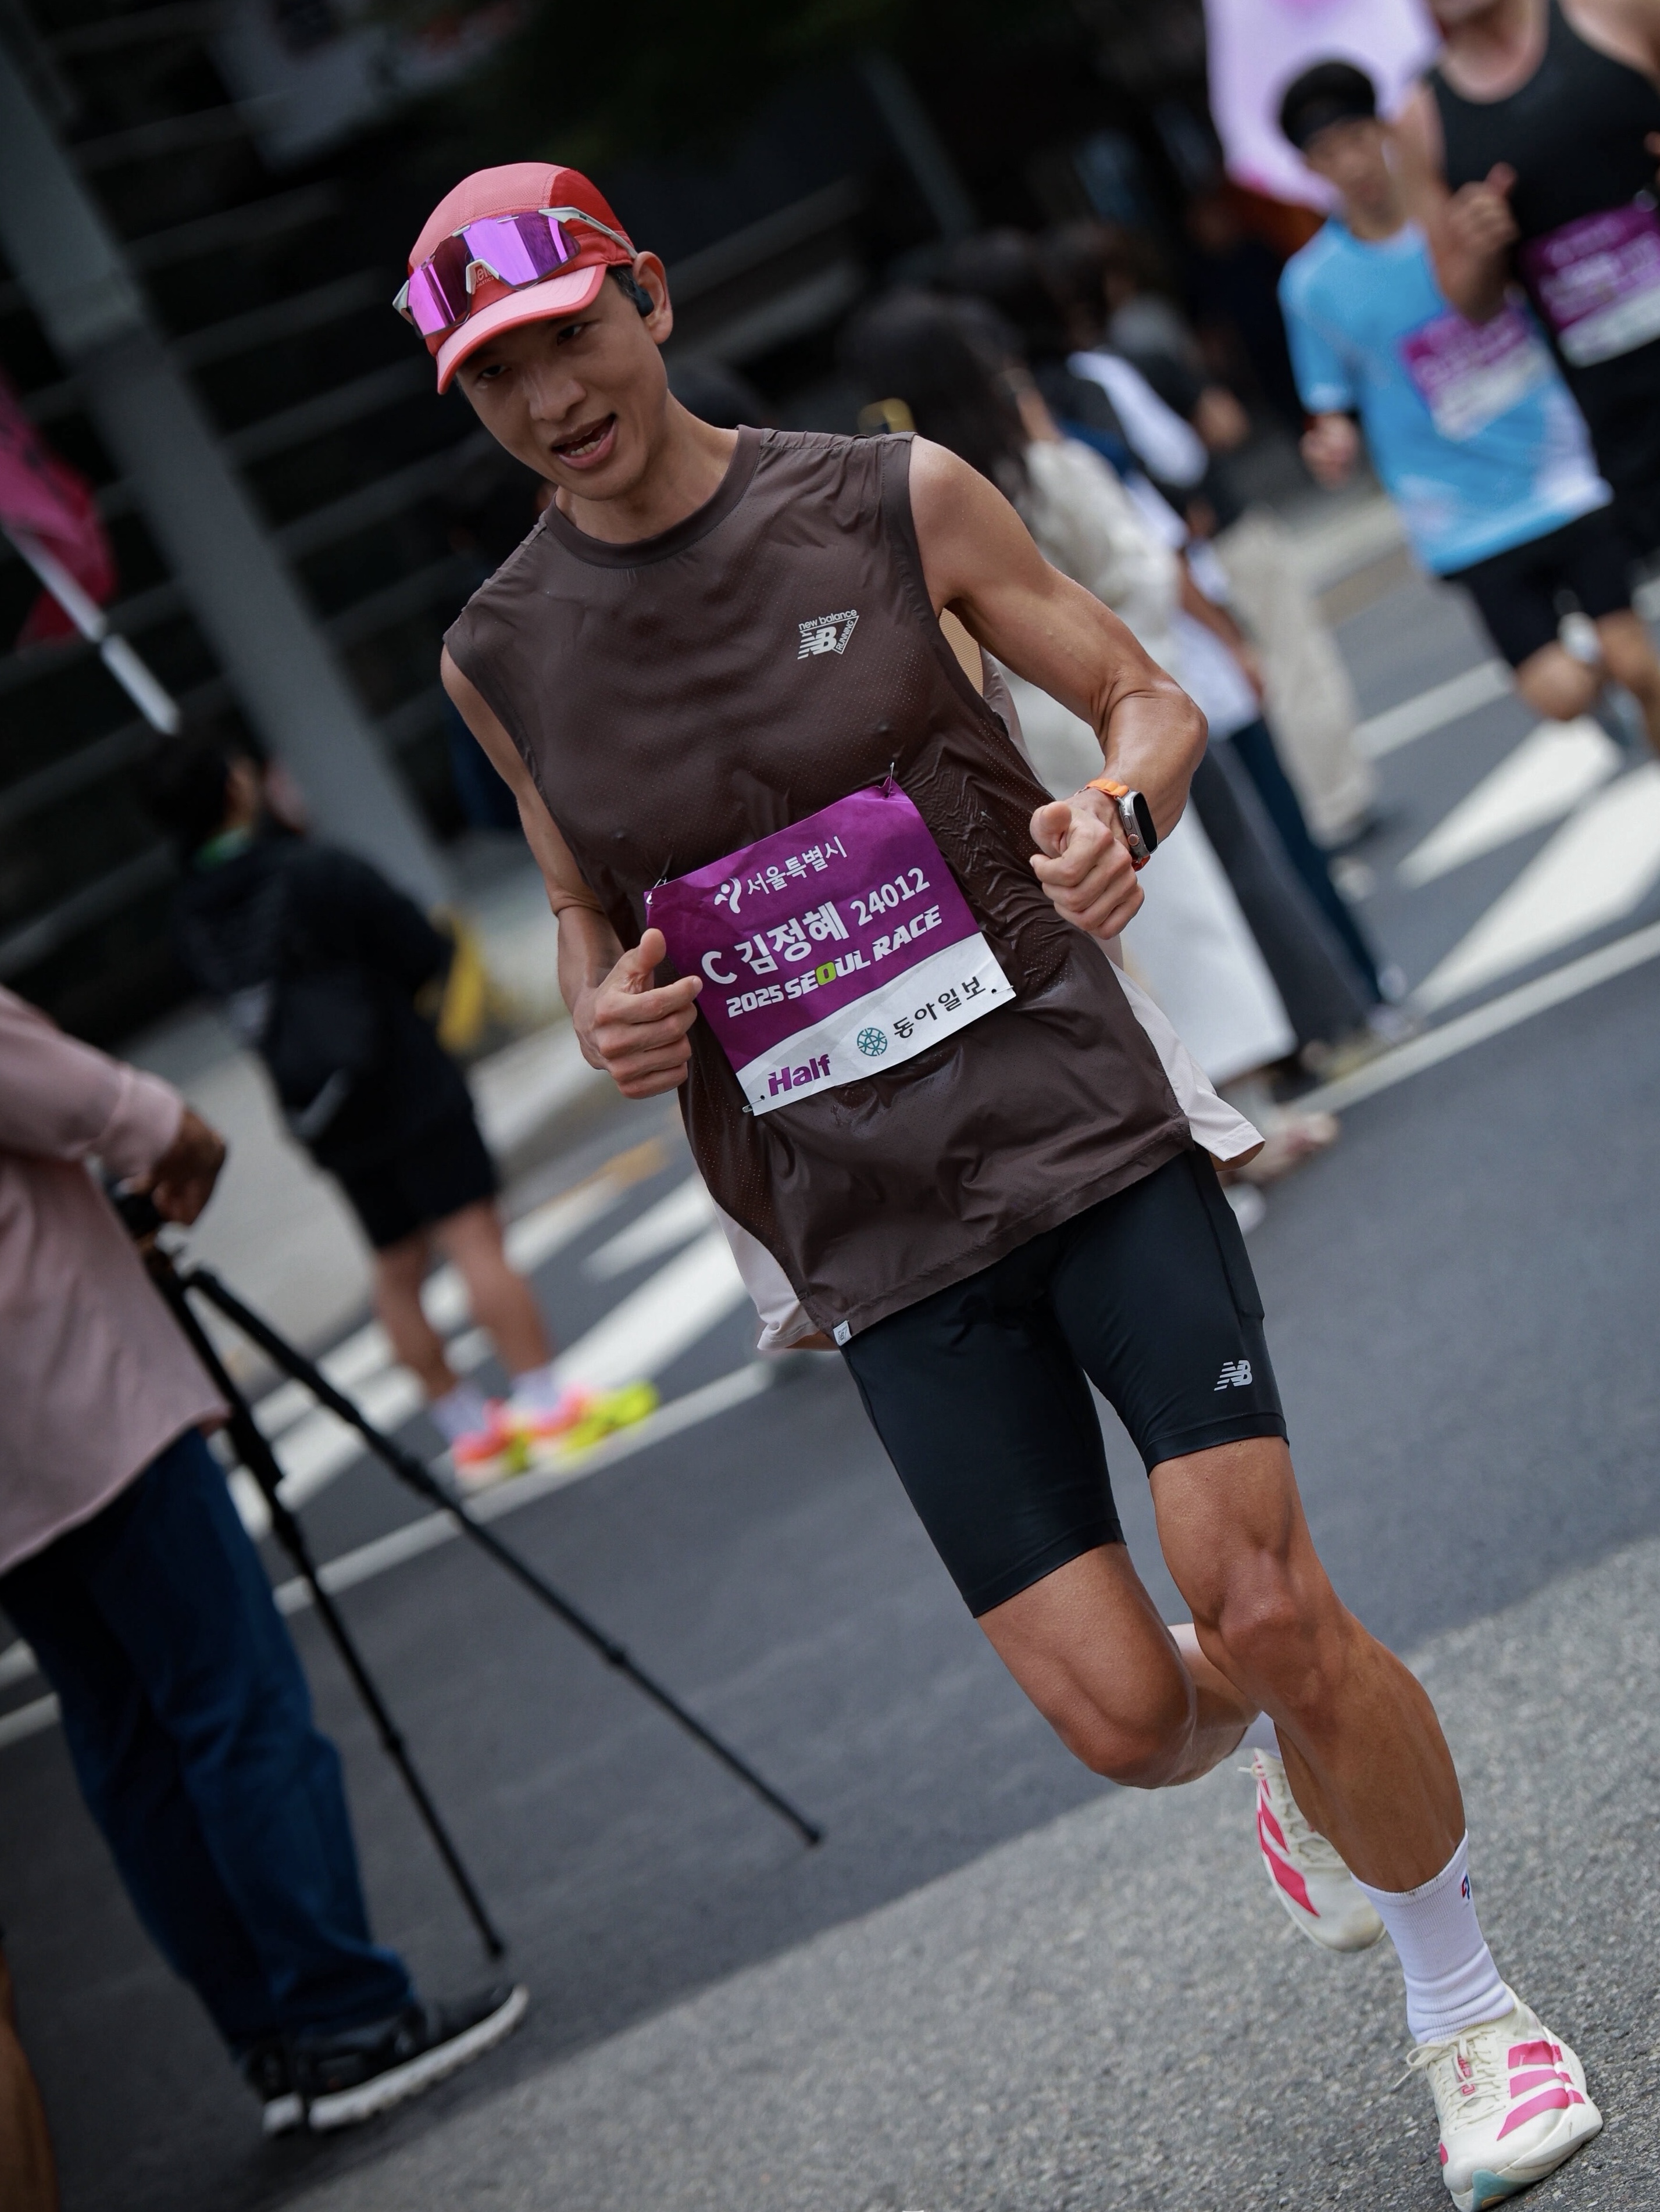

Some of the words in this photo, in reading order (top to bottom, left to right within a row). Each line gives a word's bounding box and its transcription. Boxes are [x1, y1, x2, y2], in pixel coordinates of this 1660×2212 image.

[476, 276, 494, 290] THLETICS
[798, 619, 818, 631] new
[819, 609, 857, 624] balance
[836, 620, 854, 651] RUNNING
[747, 836, 847, 896] 서울특별시
[701, 950, 738, 985] C
[734, 900, 850, 976] 김정혜
[849, 867, 930, 927] 24012
[726, 984, 784, 1019] 2025
[787, 952, 871, 1000] SEOUL
[873, 905, 942, 962] RACE
[893, 977, 986, 1039] 동아일보
[767, 1053, 831, 1098] Half
